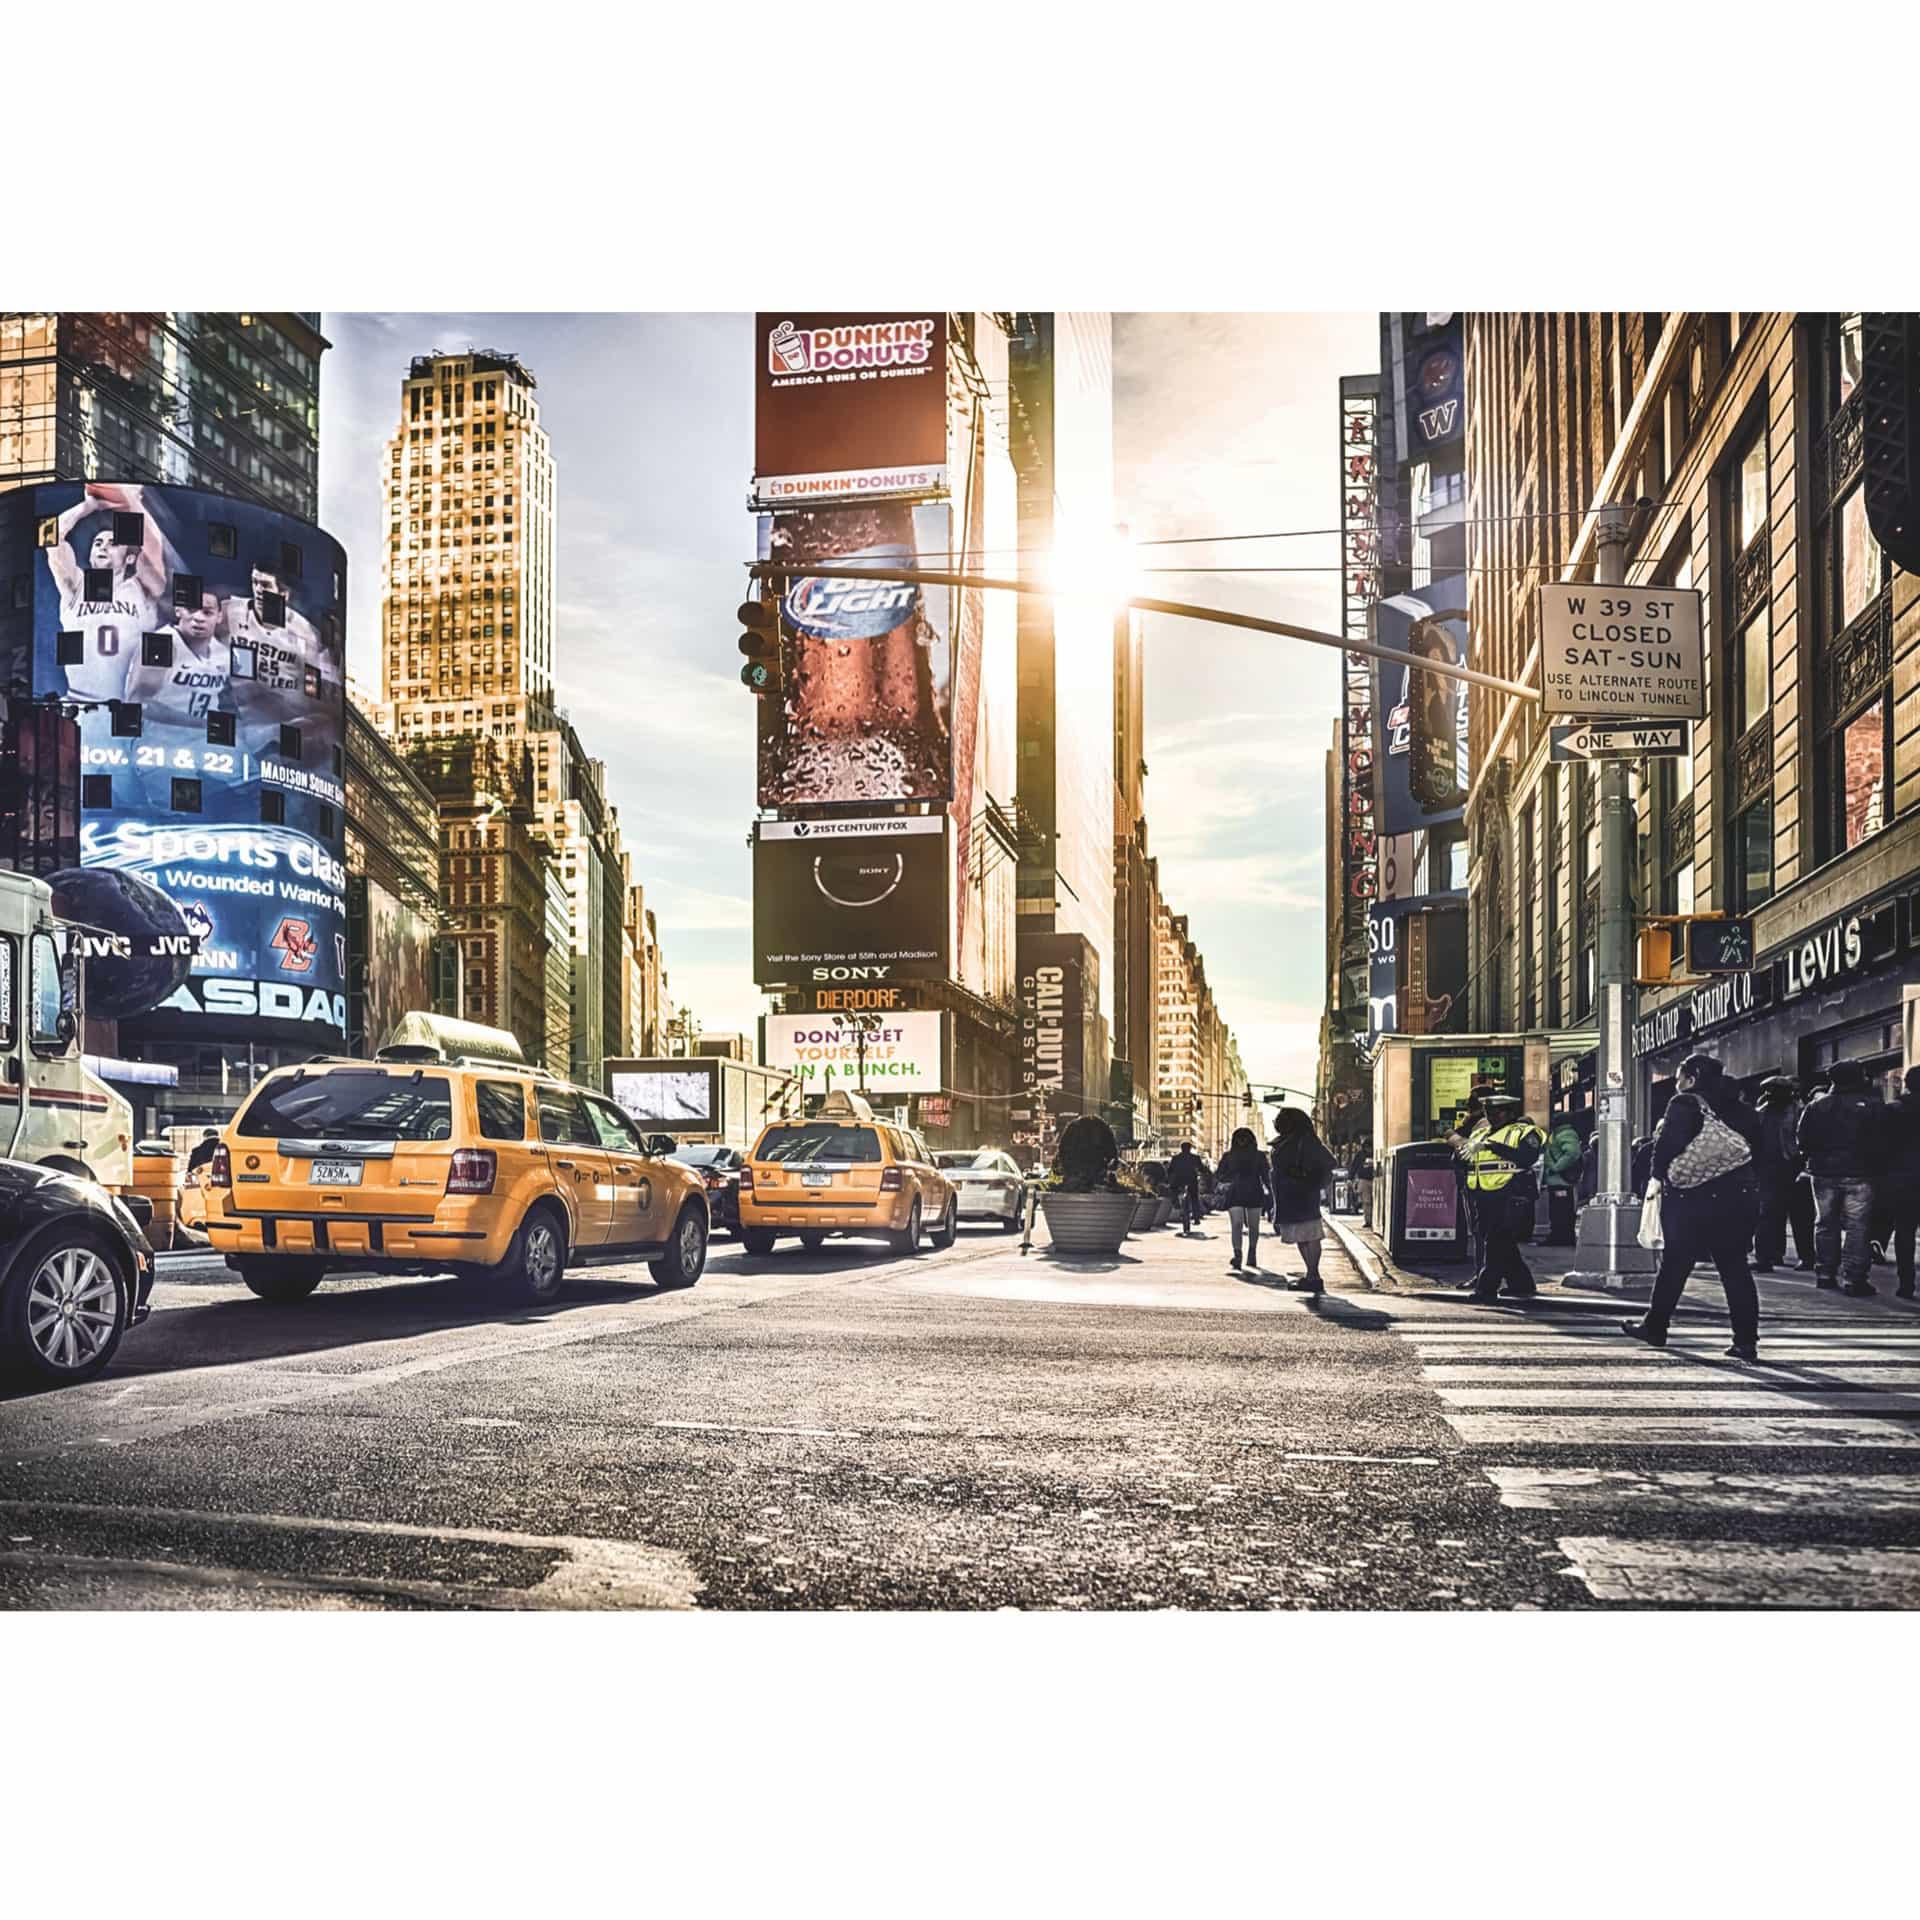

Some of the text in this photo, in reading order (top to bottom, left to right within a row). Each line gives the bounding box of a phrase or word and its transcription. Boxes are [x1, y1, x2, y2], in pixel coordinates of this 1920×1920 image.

[814, 321, 932, 350] DUNKIN'
[814, 342, 927, 369] DONUTS
[772, 376, 823, 387] AMERICA
[827, 373, 856, 382] RUNS
[859, 371, 878, 380] ON
[857, 472, 928, 488] DONUTS
[804, 587, 915, 616] LIGHT
[1568, 598, 1674, 619] W 39 ST
[1572, 623, 1671, 644] CLOSED
[1565, 648, 1681, 669] SAT-SUN
[1547, 673, 1698, 690] USE ALTERNATE ROUTE
[1557, 689, 1690, 705] TO LINCOLN TUNNEL
[1577, 731, 1672, 749] ONE WAY
[136, 746, 164, 766] 21
[173, 749, 195, 768] &
[203, 752, 234, 774] 22
[261, 760, 308, 788] MADISON
[813, 821, 908, 833] 21ST CENTURY FOX
[116, 823, 277, 868] Sports
[165, 869, 274, 896] Wounded
[279, 882, 332, 909] Warrior
[150, 936, 191, 956] JVC
[767, 955, 783, 963] Visit
[785, 954, 799, 962] the
[801, 953, 822, 963] Sony
[824, 953, 845, 961] Store
[848, 952, 857, 960] at
[878, 951, 897, 959] and
[899, 950, 938, 959] Madison
[1788, 916, 1861, 992] Levi's
[812, 966, 891, 981] SONY
[1036, 966, 1064, 1020] CALL
[1691, 981, 1730, 1032] SHRIMP
[1733, 972, 1754, 1013] CO.
[794, 1029, 903, 1043] DON'T GET
[794, 1062, 921, 1076] IN A BUNCH.
